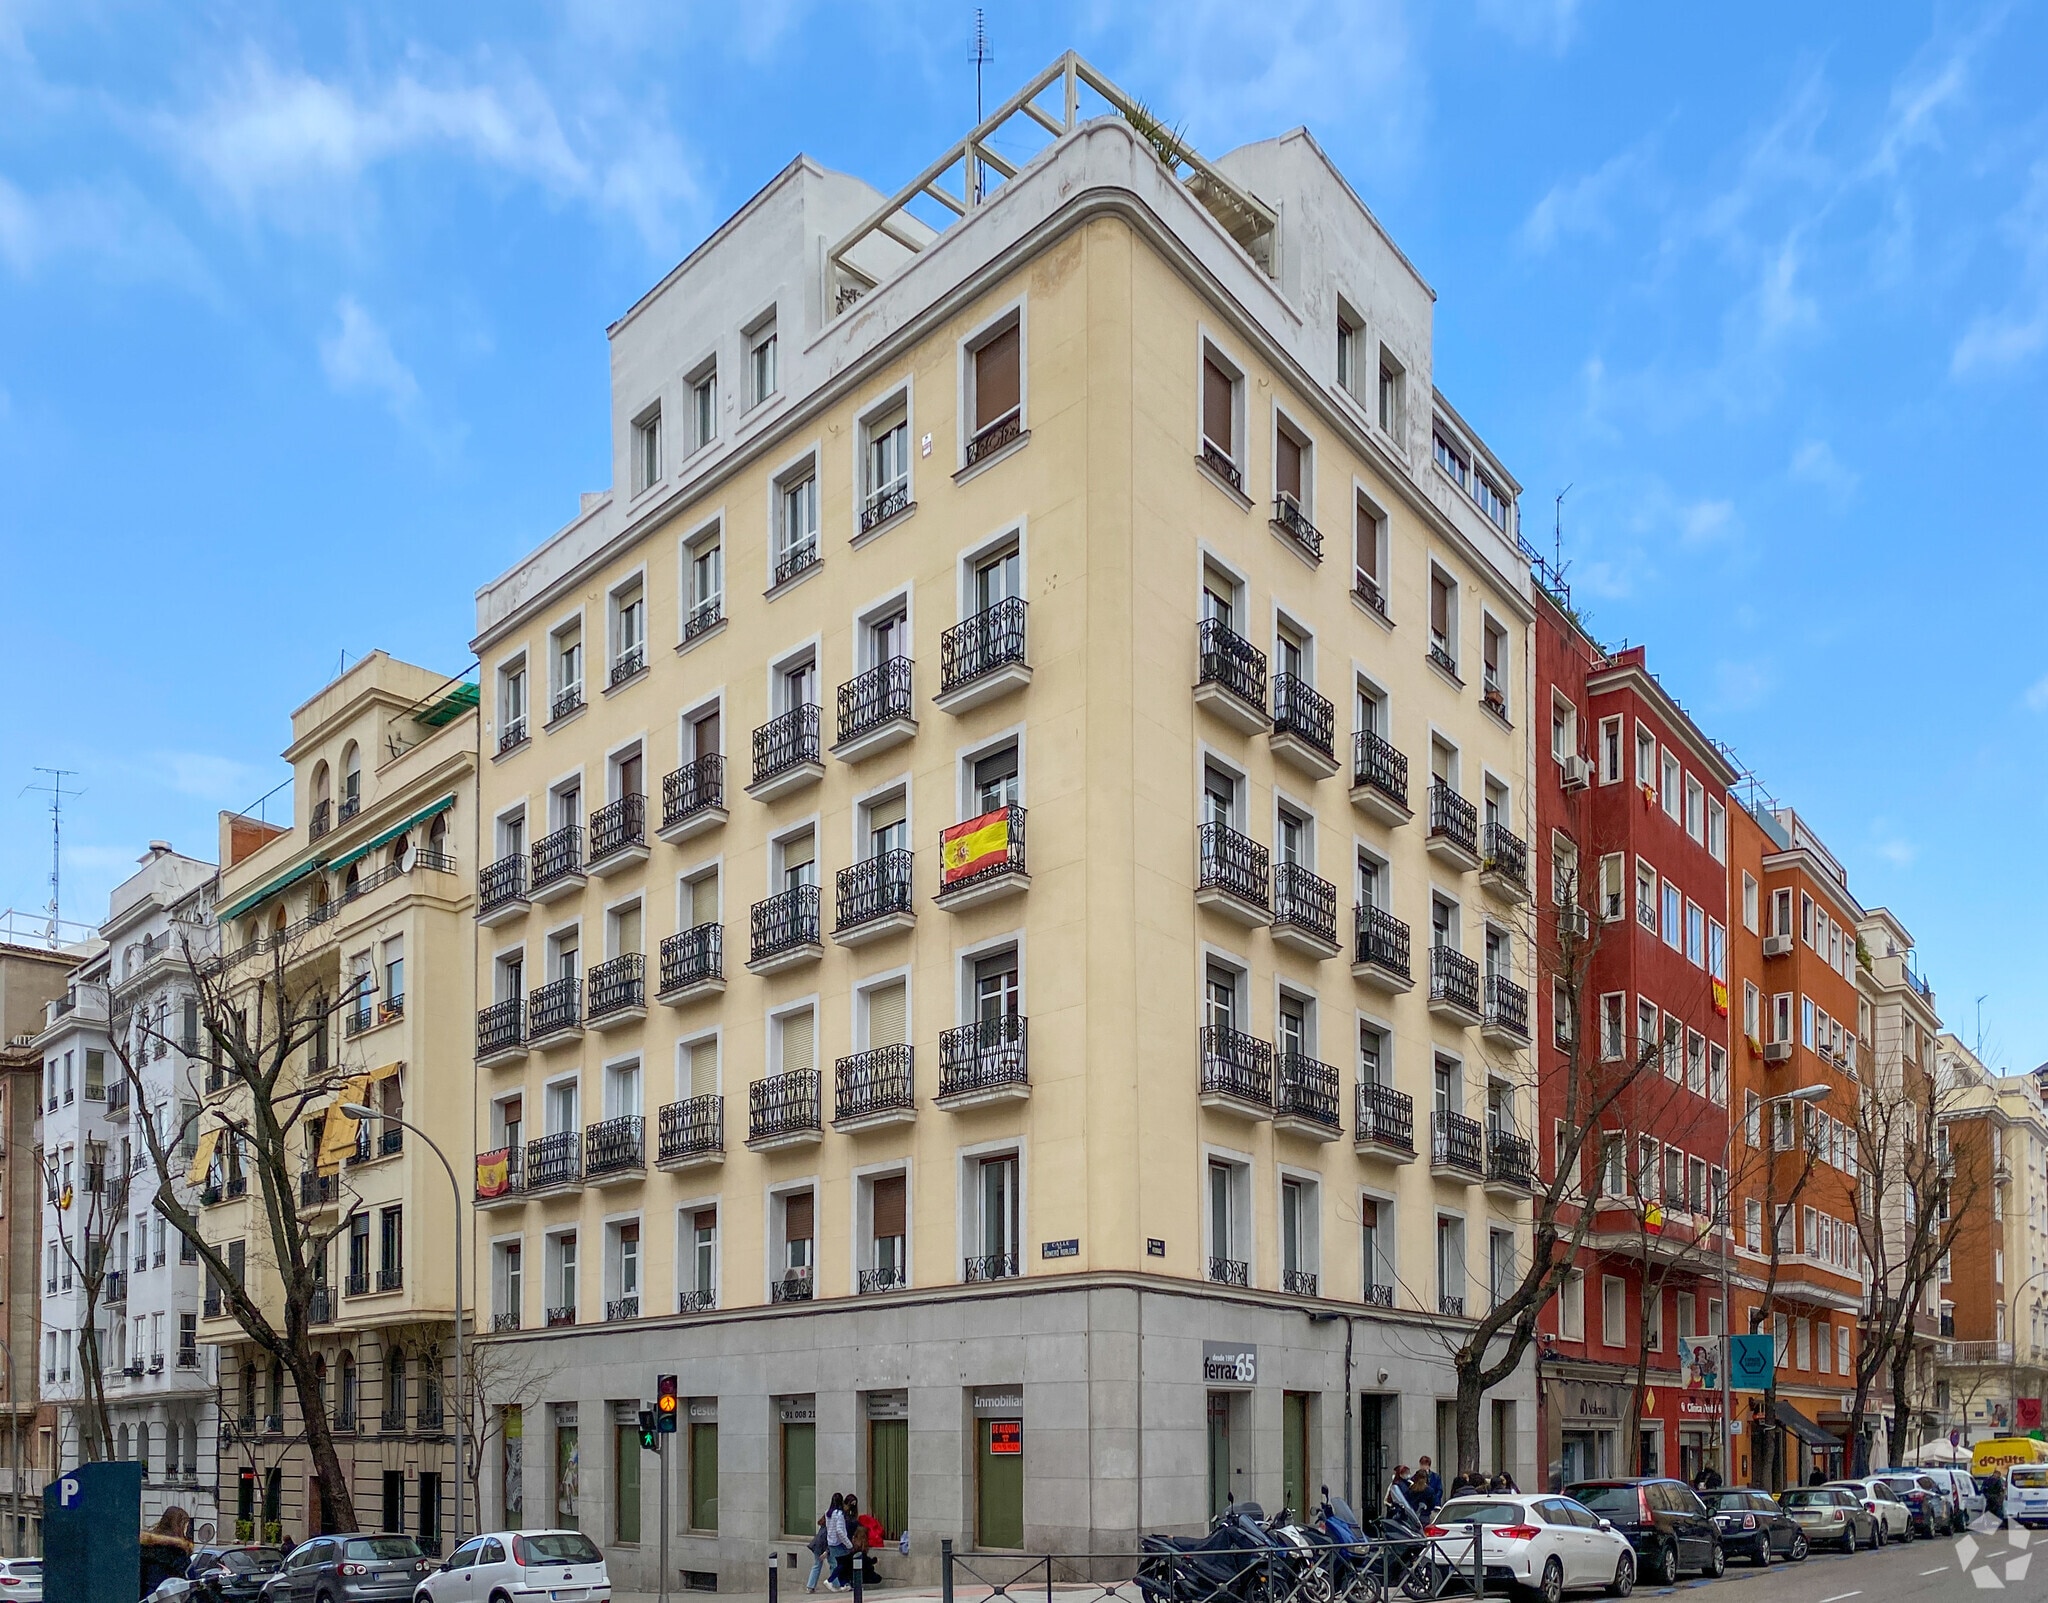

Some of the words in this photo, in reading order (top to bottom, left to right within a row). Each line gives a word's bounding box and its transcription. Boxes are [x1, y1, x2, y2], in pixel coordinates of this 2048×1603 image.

[1051, 1240, 1070, 1248] CALLE
[1212, 1353, 1225, 1361] desde
[785, 1410, 793, 1419] 91
[794, 1409, 807, 1419] 008
[992, 1424, 998, 1434] SE
[999, 1423, 1020, 1433] ALQUILA
[1979, 1454, 2026, 1468] donuts
[61, 1478, 79, 1506] P
